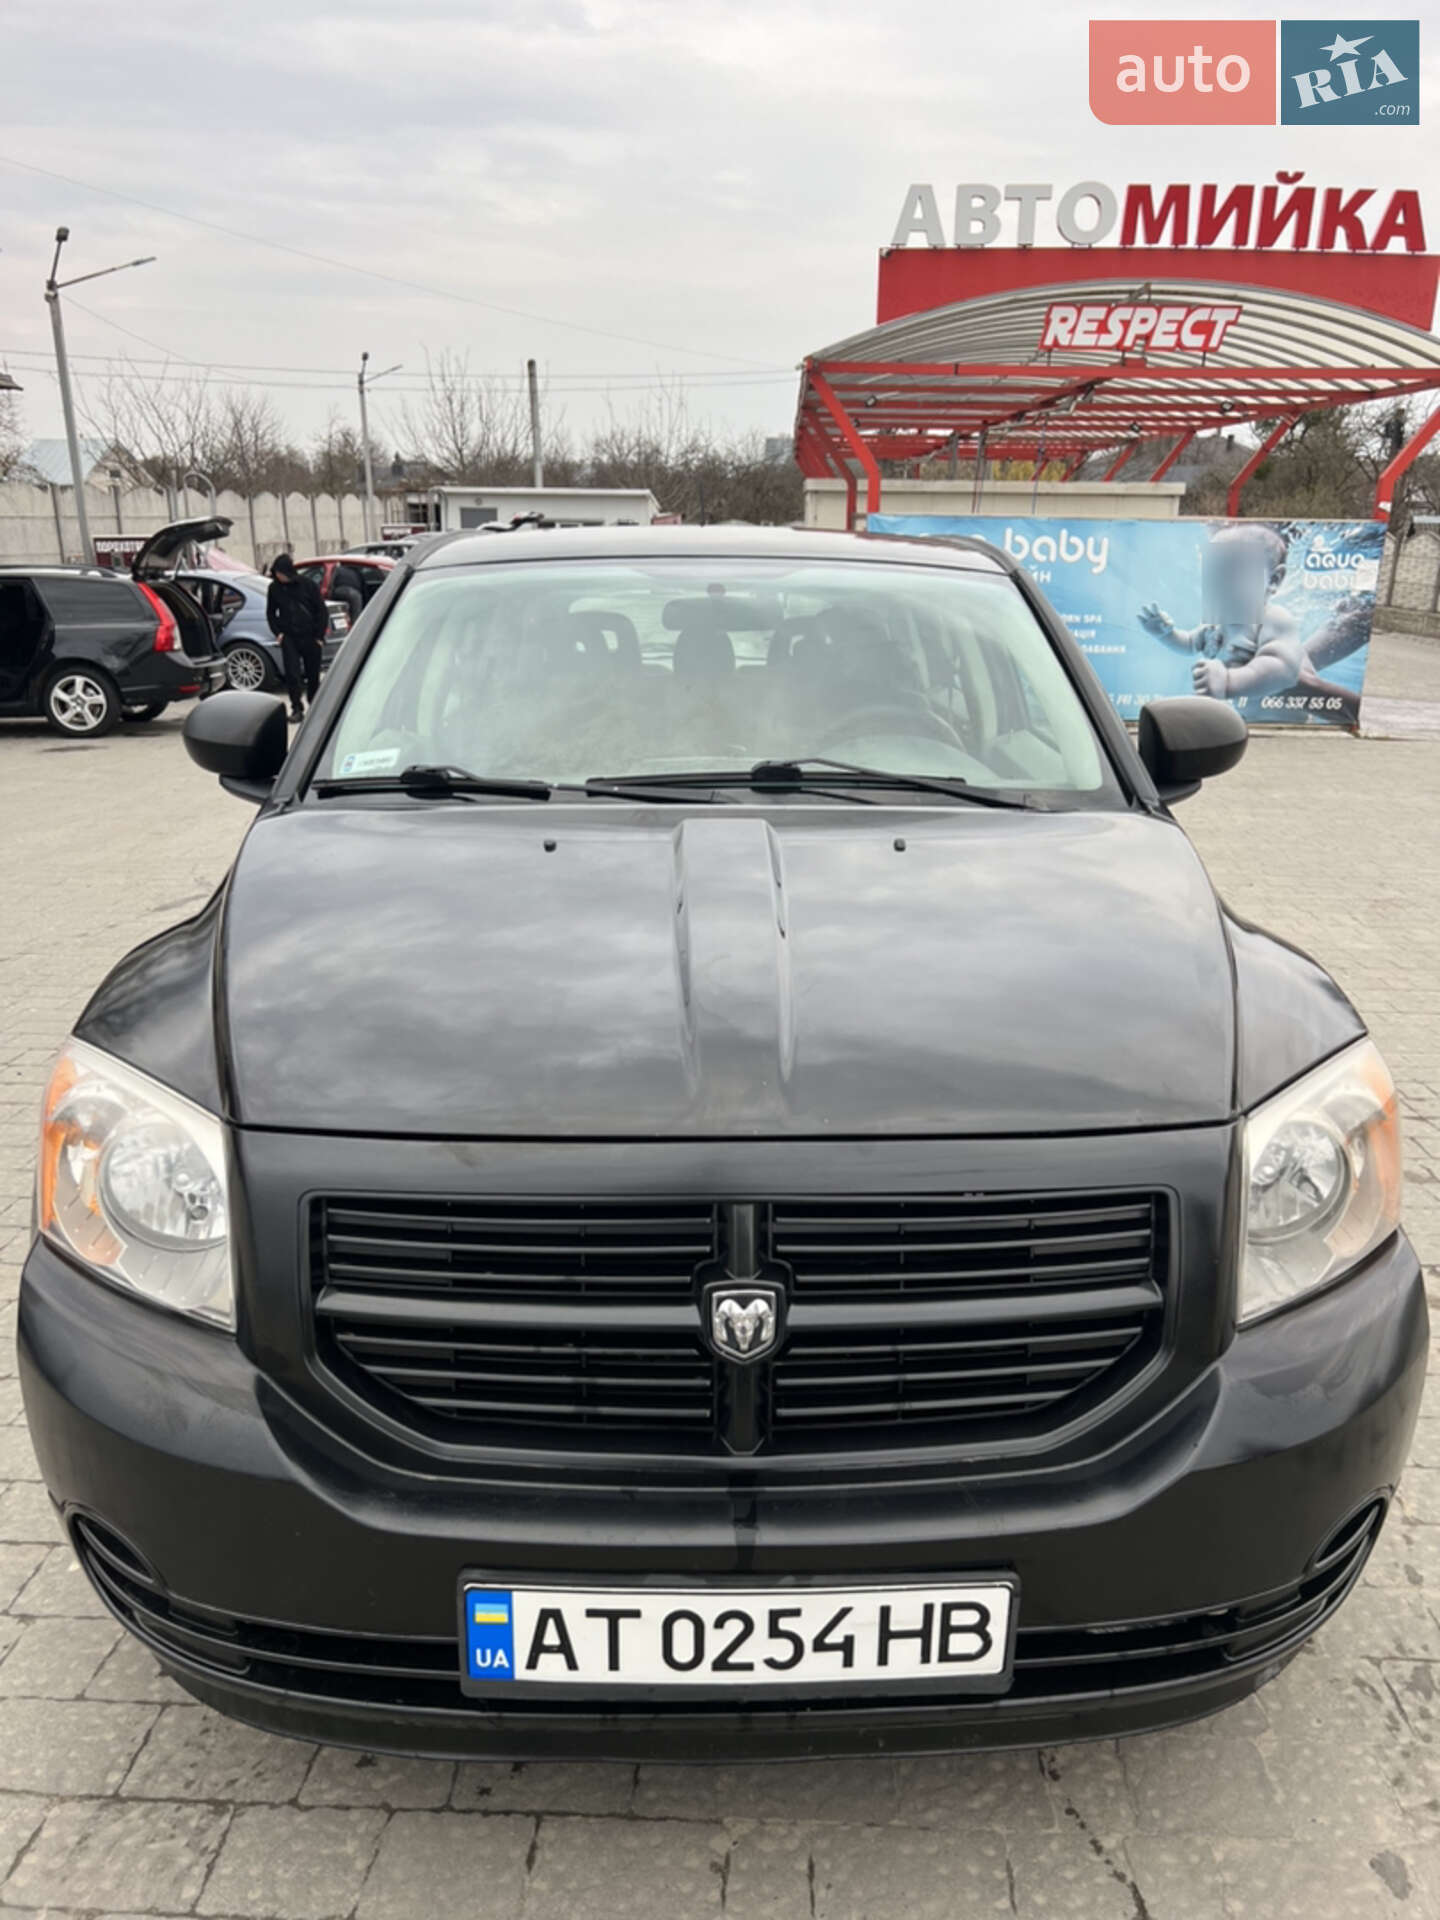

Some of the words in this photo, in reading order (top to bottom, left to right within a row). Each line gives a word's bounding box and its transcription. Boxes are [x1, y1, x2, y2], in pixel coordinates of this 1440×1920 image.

[888, 171, 1427, 252] АВТОМИЙКА
[1042, 305, 1242, 350] RESPECT
[1003, 527, 1109, 574] baby
[476, 1648, 510, 1668] UA
[525, 1608, 642, 1671] AT
[661, 1606, 855, 1671] 0254
[876, 1602, 994, 1665] HB
